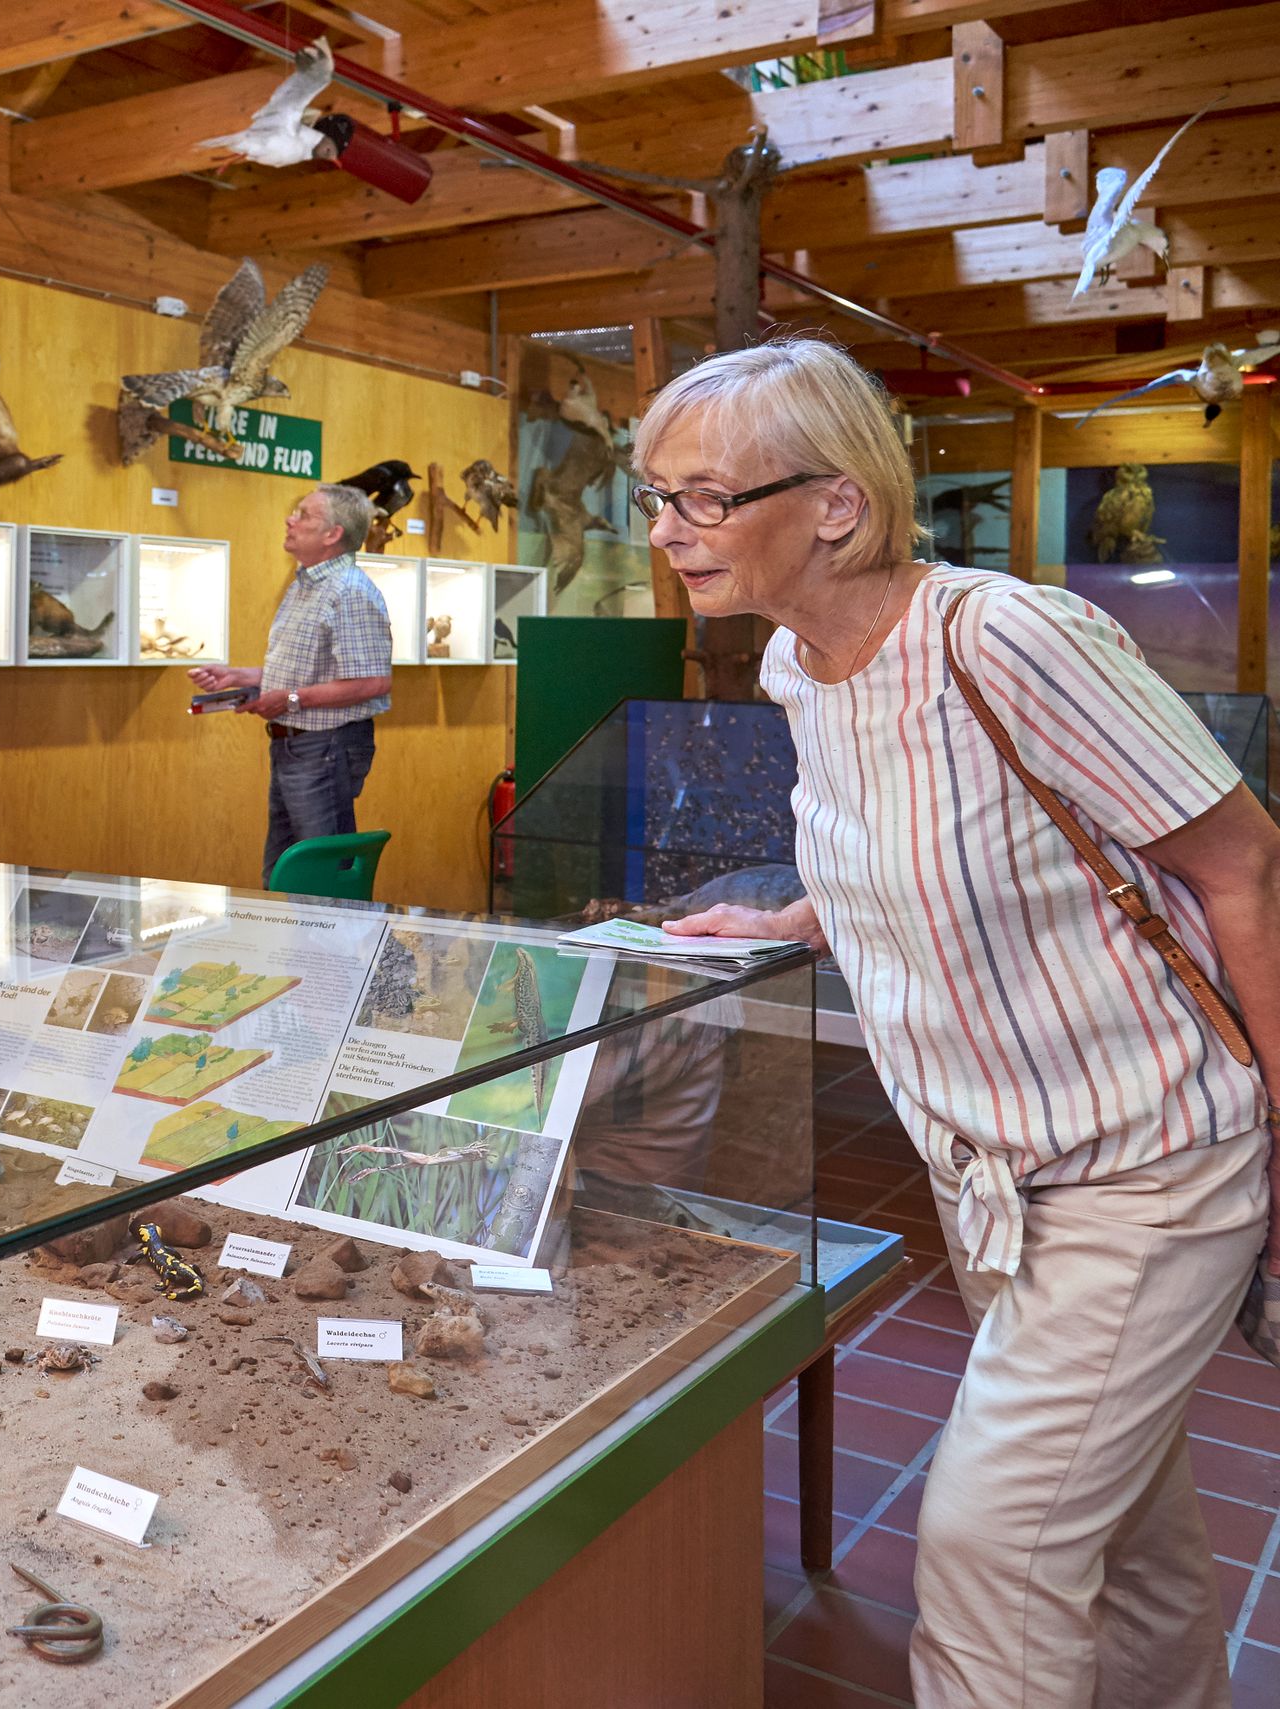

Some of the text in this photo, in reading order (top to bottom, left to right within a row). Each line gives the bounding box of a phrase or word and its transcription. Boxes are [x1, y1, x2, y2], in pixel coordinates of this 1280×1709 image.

[258, 414, 277, 440] IN
[273, 446, 314, 476] FLUR
[264, 915, 299, 926] werden
[20, 984, 38, 995] sind
[37, 987, 52, 997] der
[361, 1039, 387, 1050] Jungen
[345, 1045, 406, 1061] werfen zum Spaß
[355, 1054, 383, 1064] Steinen
[383, 1058, 401, 1067] nach
[338, 1063, 380, 1076] Die Frösche
[335, 1072, 396, 1088] sterben im Ernst.
[228, 1243, 277, 1258] Feuersalamander
[326, 1329, 376, 1338] Waldeidechse
[76, 1482, 131, 1508] Blindschleiche
